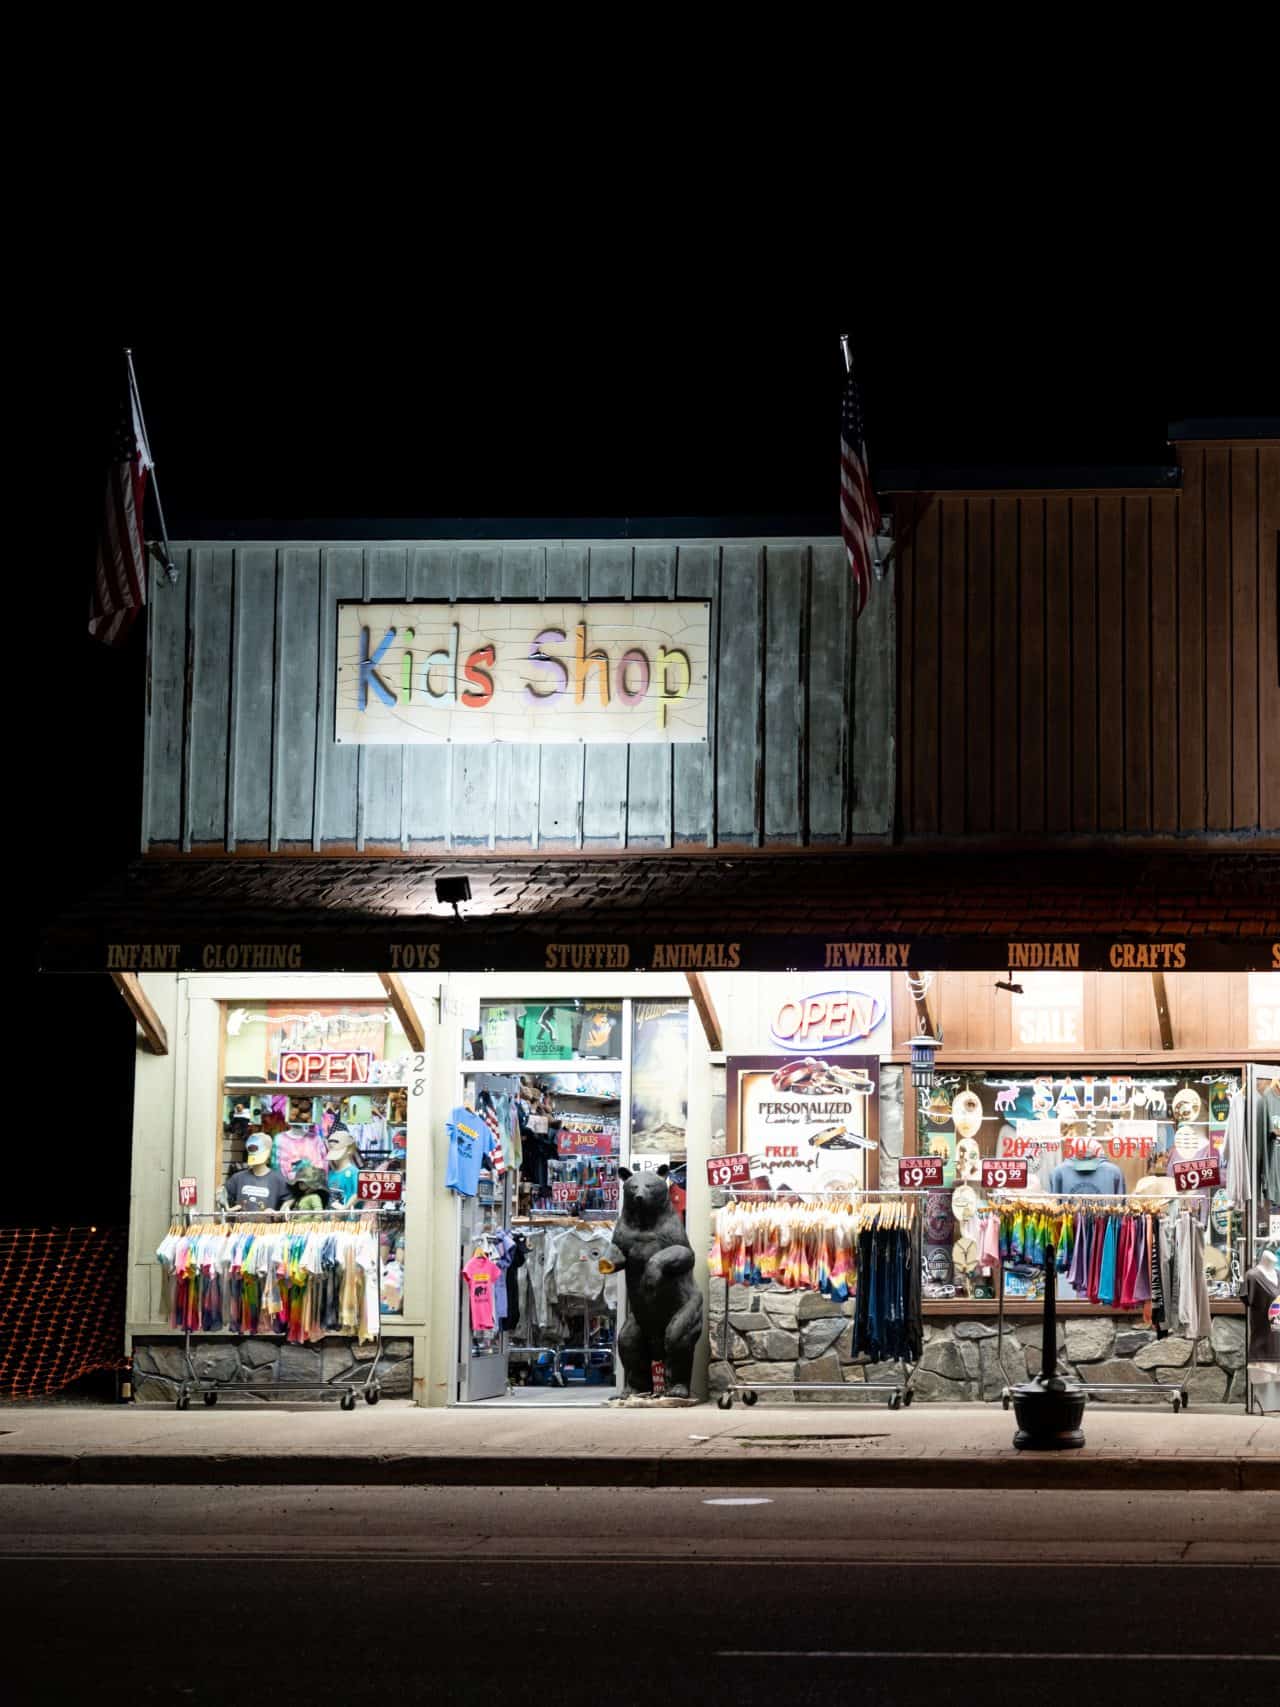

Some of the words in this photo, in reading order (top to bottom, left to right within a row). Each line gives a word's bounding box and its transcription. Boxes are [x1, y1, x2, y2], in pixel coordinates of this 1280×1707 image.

[357, 621, 497, 713] Kids
[522, 621, 693, 734] Shop
[107, 944, 181, 969] INFANT
[203, 944, 302, 969] CLOTHING
[390, 943, 440, 969] TOYS
[545, 943, 630, 968] STUFFED
[652, 943, 741, 968] ANIMALS
[824, 943, 911, 968] JEWELRY
[1007, 943, 1080, 968] INDIAN
[1110, 943, 1186, 969] CRAFTS
[773, 997, 876, 1040] OPEN
[282, 1053, 370, 1083] OPEN
[1031, 1076, 1135, 1112] SALE
[758, 1102, 853, 1116] PERSONALIZED
[765, 1146, 799, 1158] FREE
[1107, 1137, 1154, 1159] OFF
